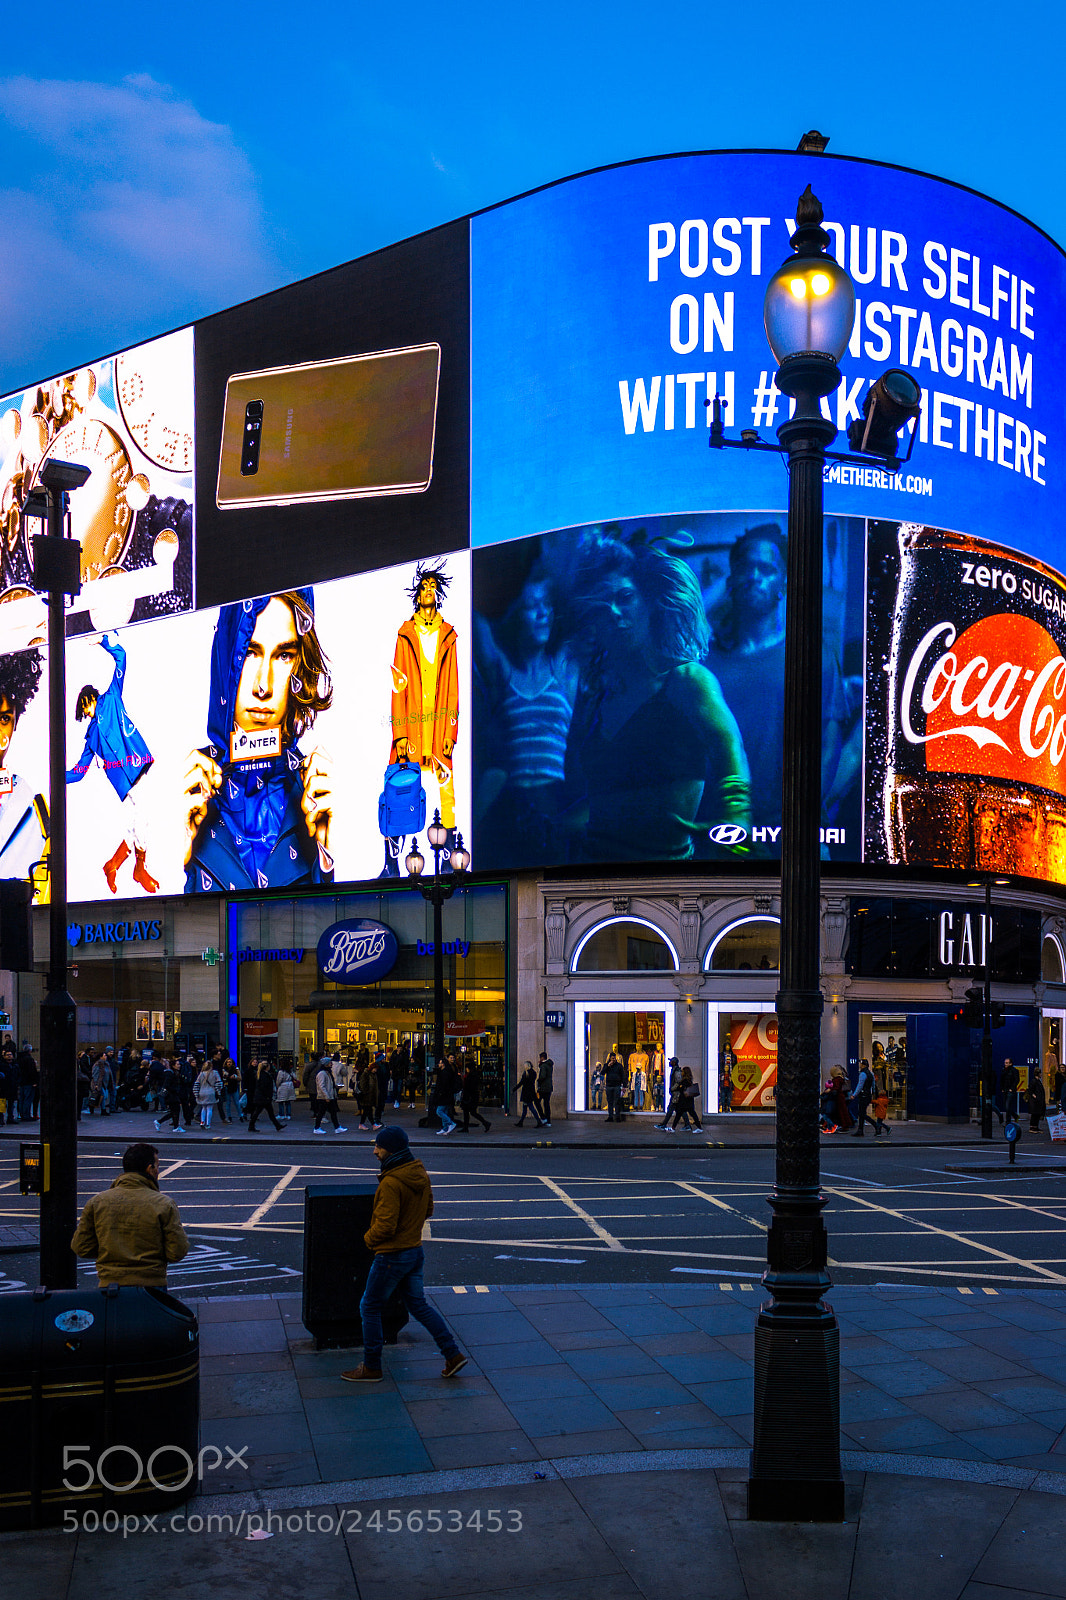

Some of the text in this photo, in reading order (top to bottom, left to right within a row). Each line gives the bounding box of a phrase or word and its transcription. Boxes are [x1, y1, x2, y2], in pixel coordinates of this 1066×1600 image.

[649, 217, 1035, 340] POST OUR SELFIE
[669, 292, 735, 355] ON
[618, 371, 735, 435] WITH
[283, 407, 294, 459] SAMSUNG
[961, 562, 1018, 594] zero
[84, 920, 162, 943] BARCLAYS
[323, 929, 386, 974] Boots
[417, 938, 471, 958] beuty
[940, 910, 993, 966] GAP
[238, 947, 304, 964] pharmacy
[24, 1158, 40, 1167] WAIT
